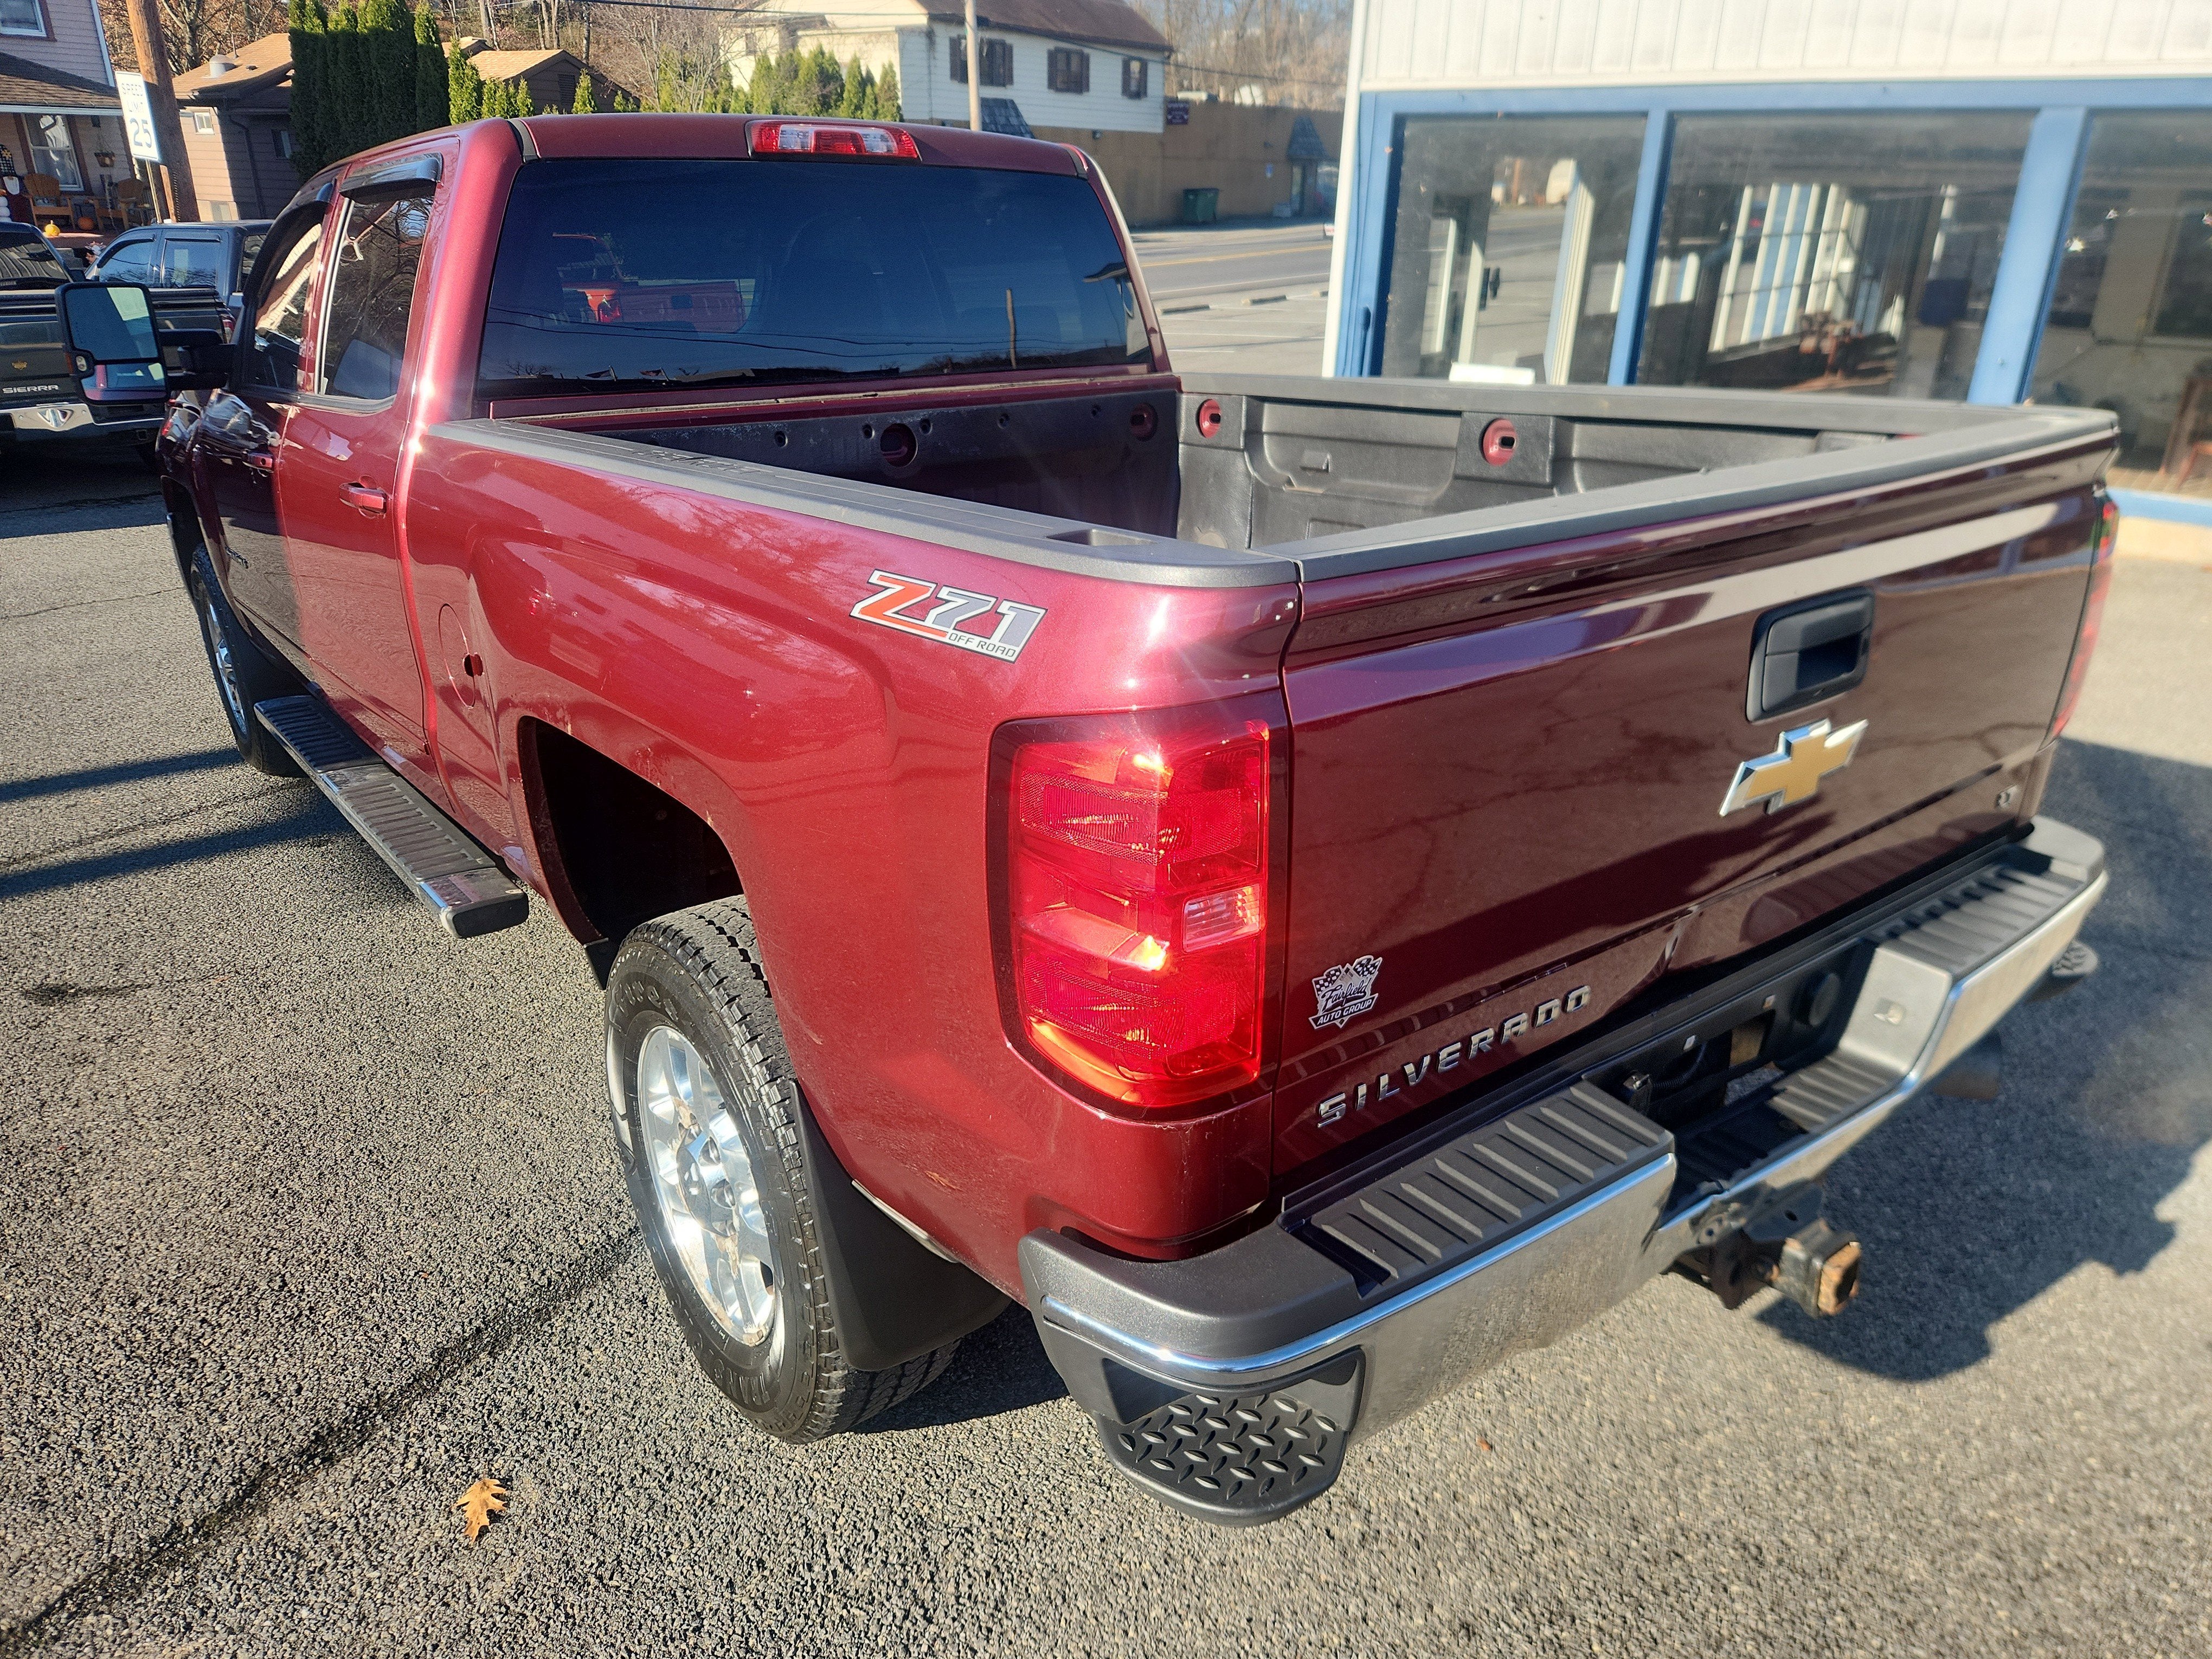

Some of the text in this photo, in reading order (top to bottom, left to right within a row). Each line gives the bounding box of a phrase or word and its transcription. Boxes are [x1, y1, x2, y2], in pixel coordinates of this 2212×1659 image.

[121, 83, 143, 97] SPEED
[130, 118, 152, 149] 25
[2, 384, 59, 394] SIERRA
[849, 568, 1049, 661] Z71
[948, 633, 1017, 658] OFF ROAD
[1321, 977, 1372, 1013] Fairfield
[1316, 998, 1373, 1026] AUTO GROUP
[1317, 985, 1592, 1128] SILVERADO
